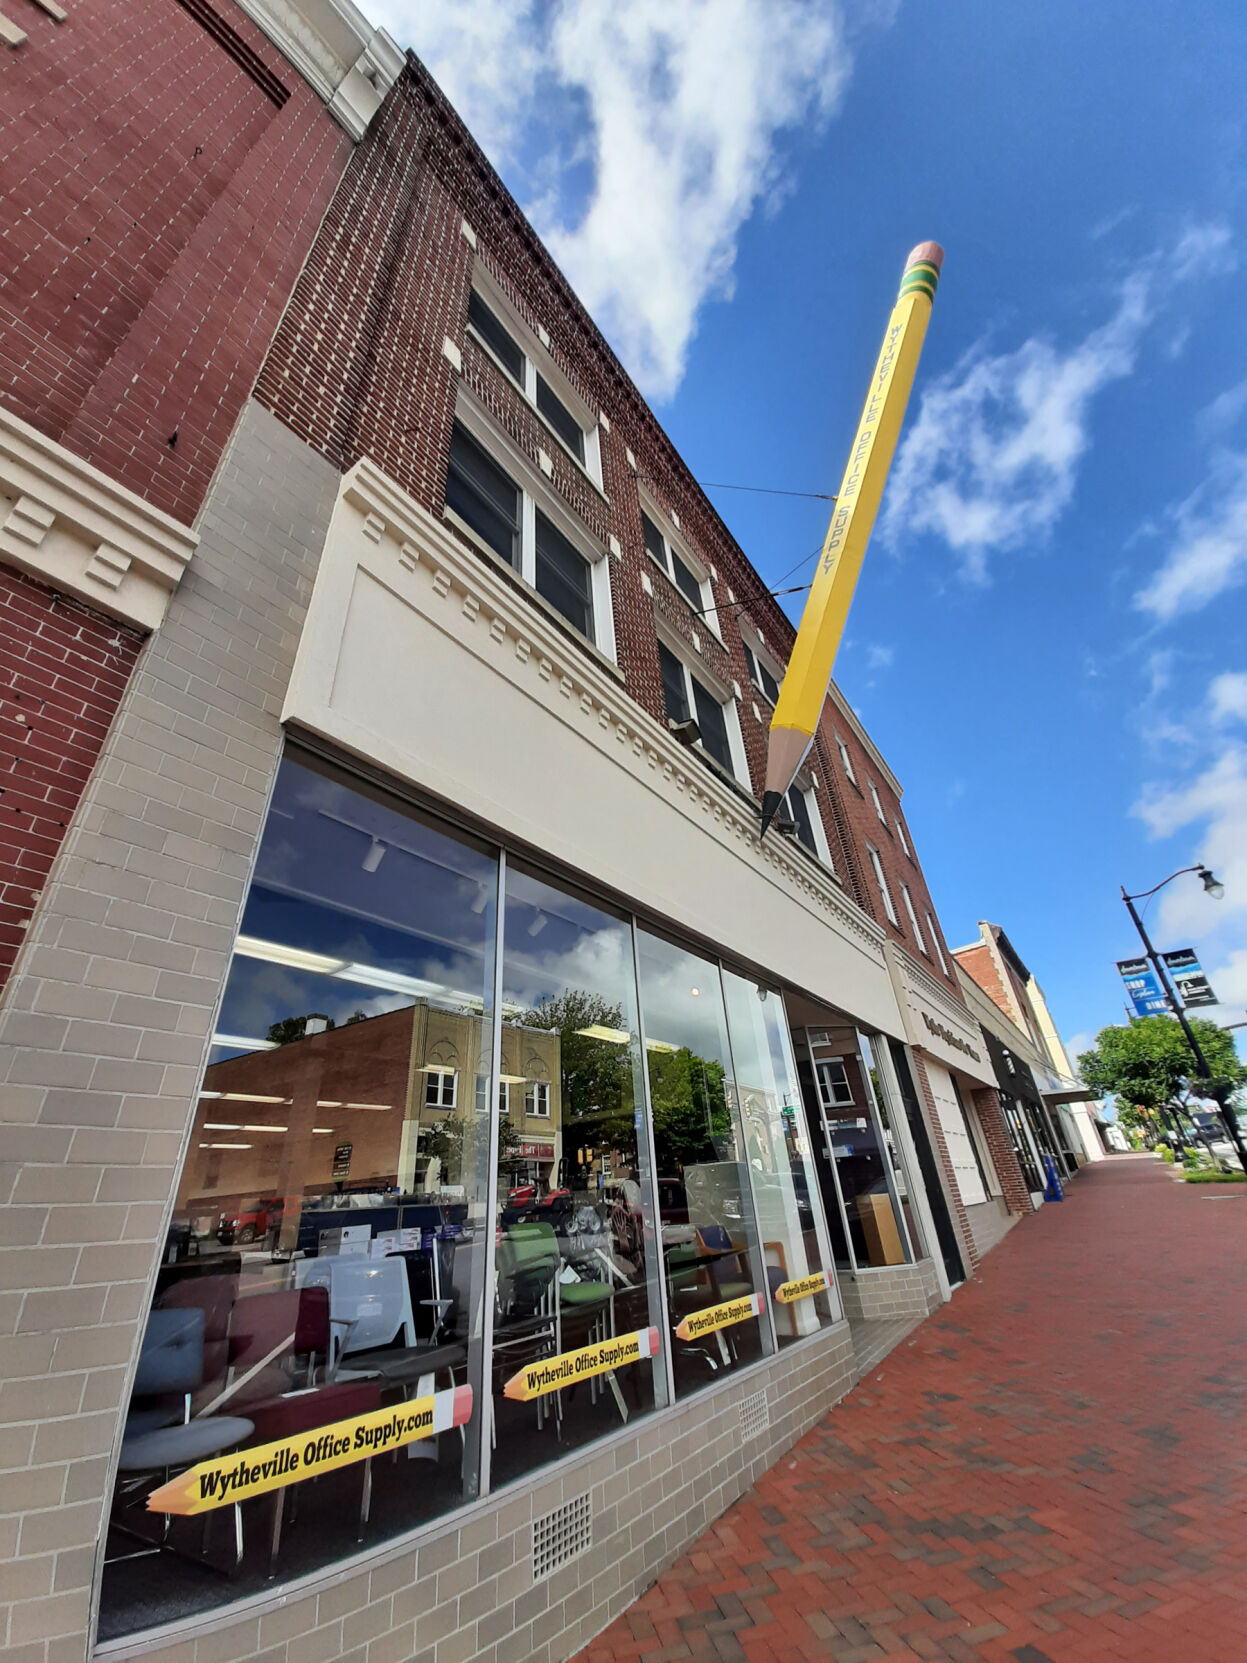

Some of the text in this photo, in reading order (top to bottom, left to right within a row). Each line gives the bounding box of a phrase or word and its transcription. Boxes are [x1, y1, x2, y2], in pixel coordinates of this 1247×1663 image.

[822, 323, 903, 575] WYTHEVILLE OFFICE SUPPLY
[688, 1312, 715, 1335] Wytheville
[715, 1309, 728, 1323] Office
[527, 1341, 639, 1392] Wytheville Office Supply.com
[200, 1409, 434, 1501] Wytheville Office Supply.com
